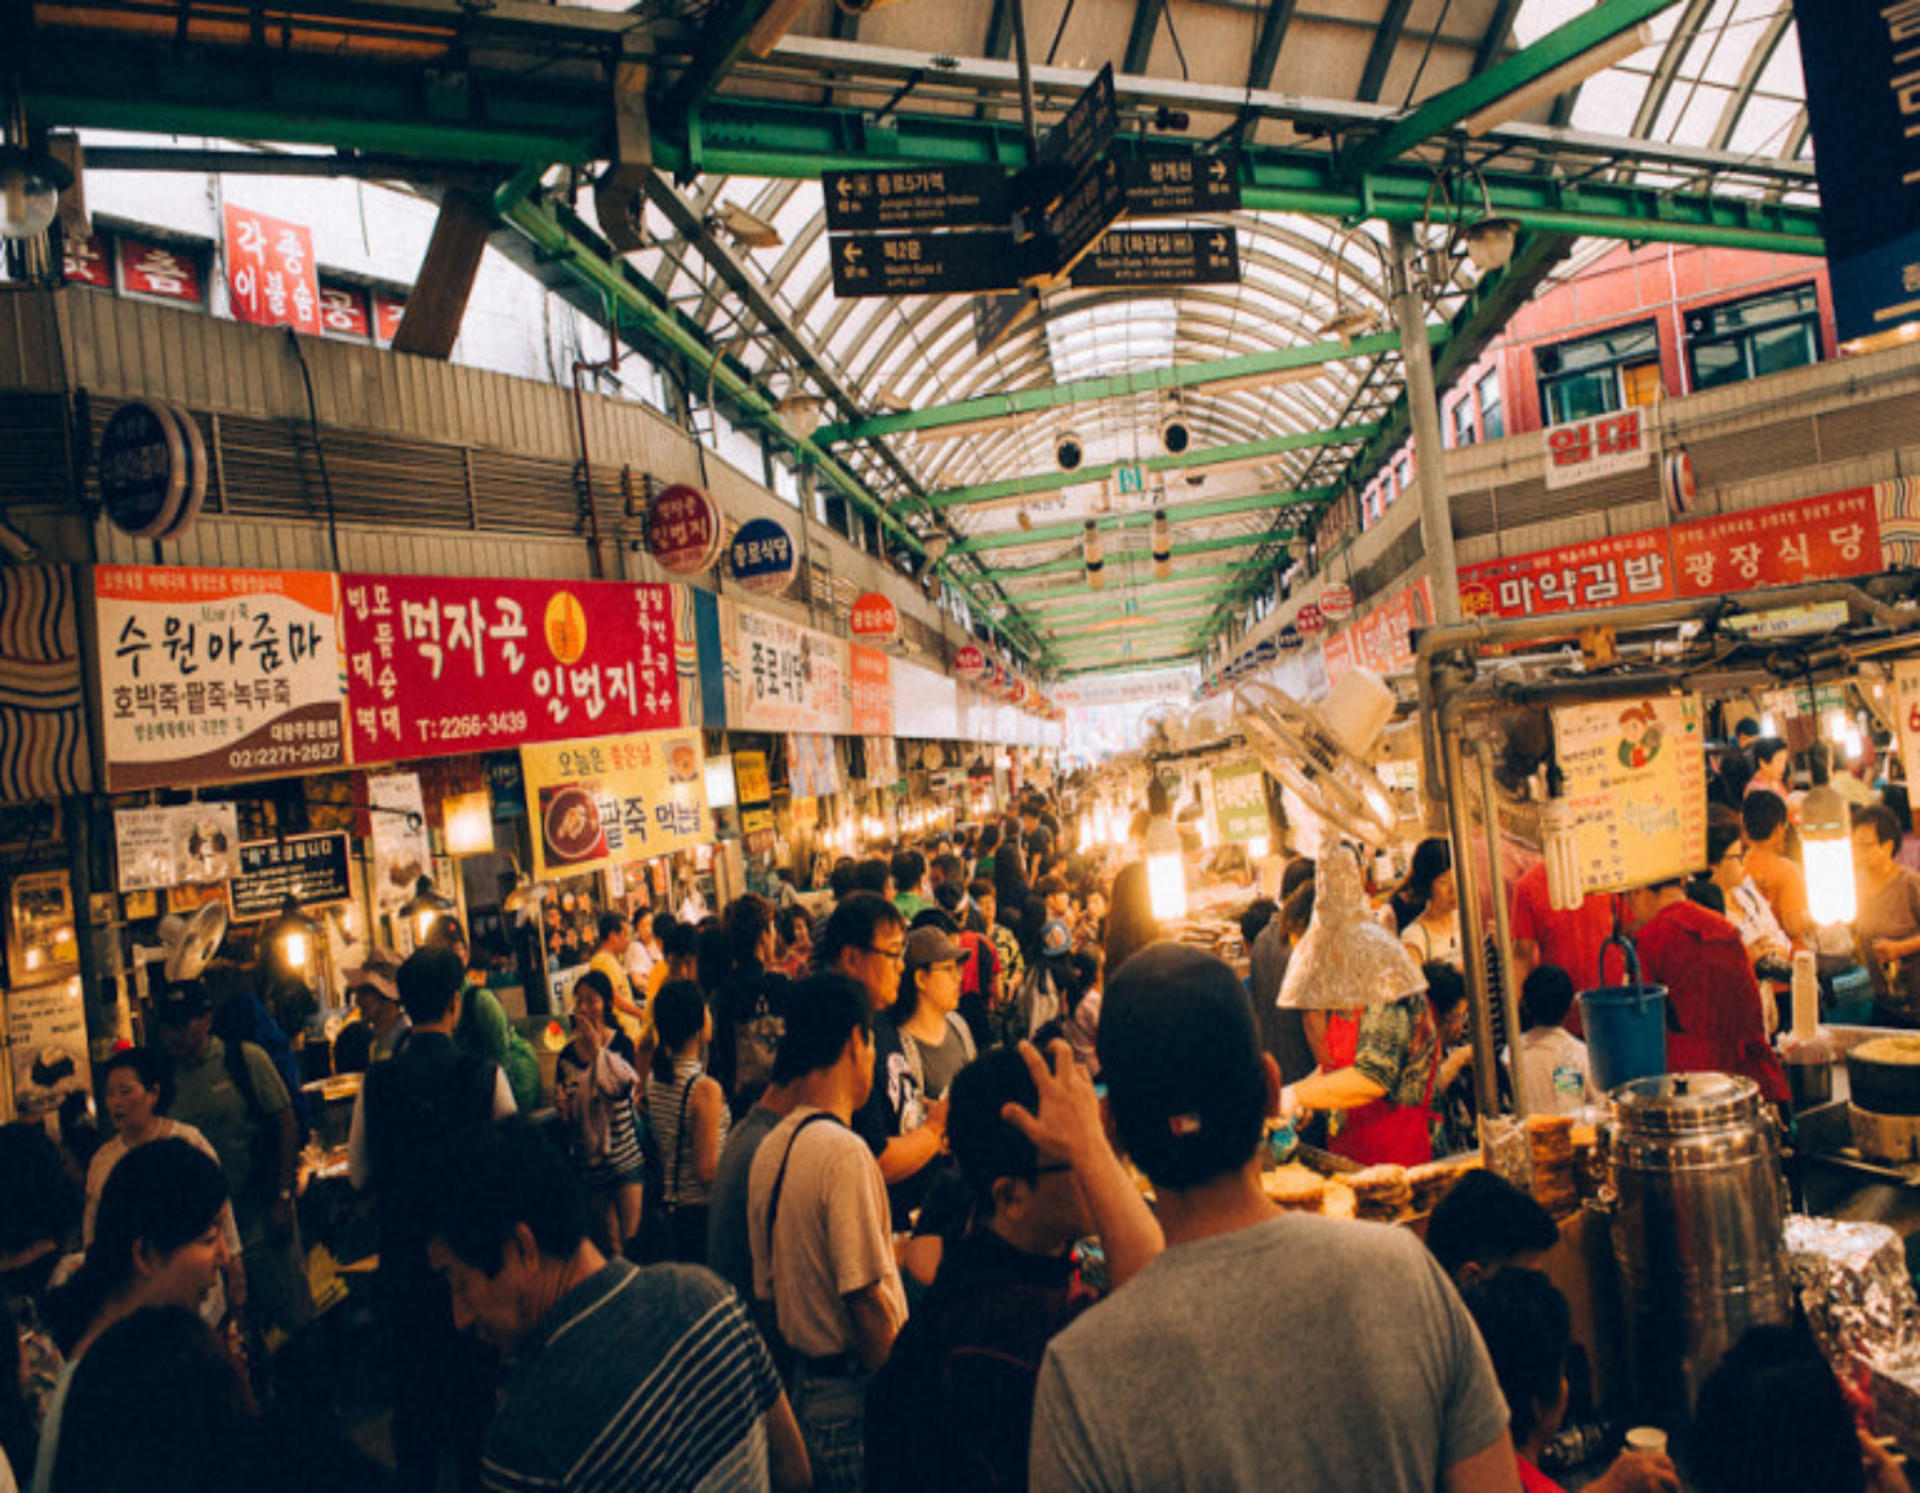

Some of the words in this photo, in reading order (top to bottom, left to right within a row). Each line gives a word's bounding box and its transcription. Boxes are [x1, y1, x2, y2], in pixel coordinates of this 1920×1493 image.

[236, 216, 303, 275] 각종
[234, 265, 314, 322] 이불솜
[1549, 411, 1640, 467] 임대
[1499, 553, 1664, 614] 마약김밥
[1684, 523, 1864, 588] 광장식당
[115, 612, 323, 678] 수원아줌마
[401, 597, 528, 680] 먹자골
[532, 660, 638, 724] 일번지
